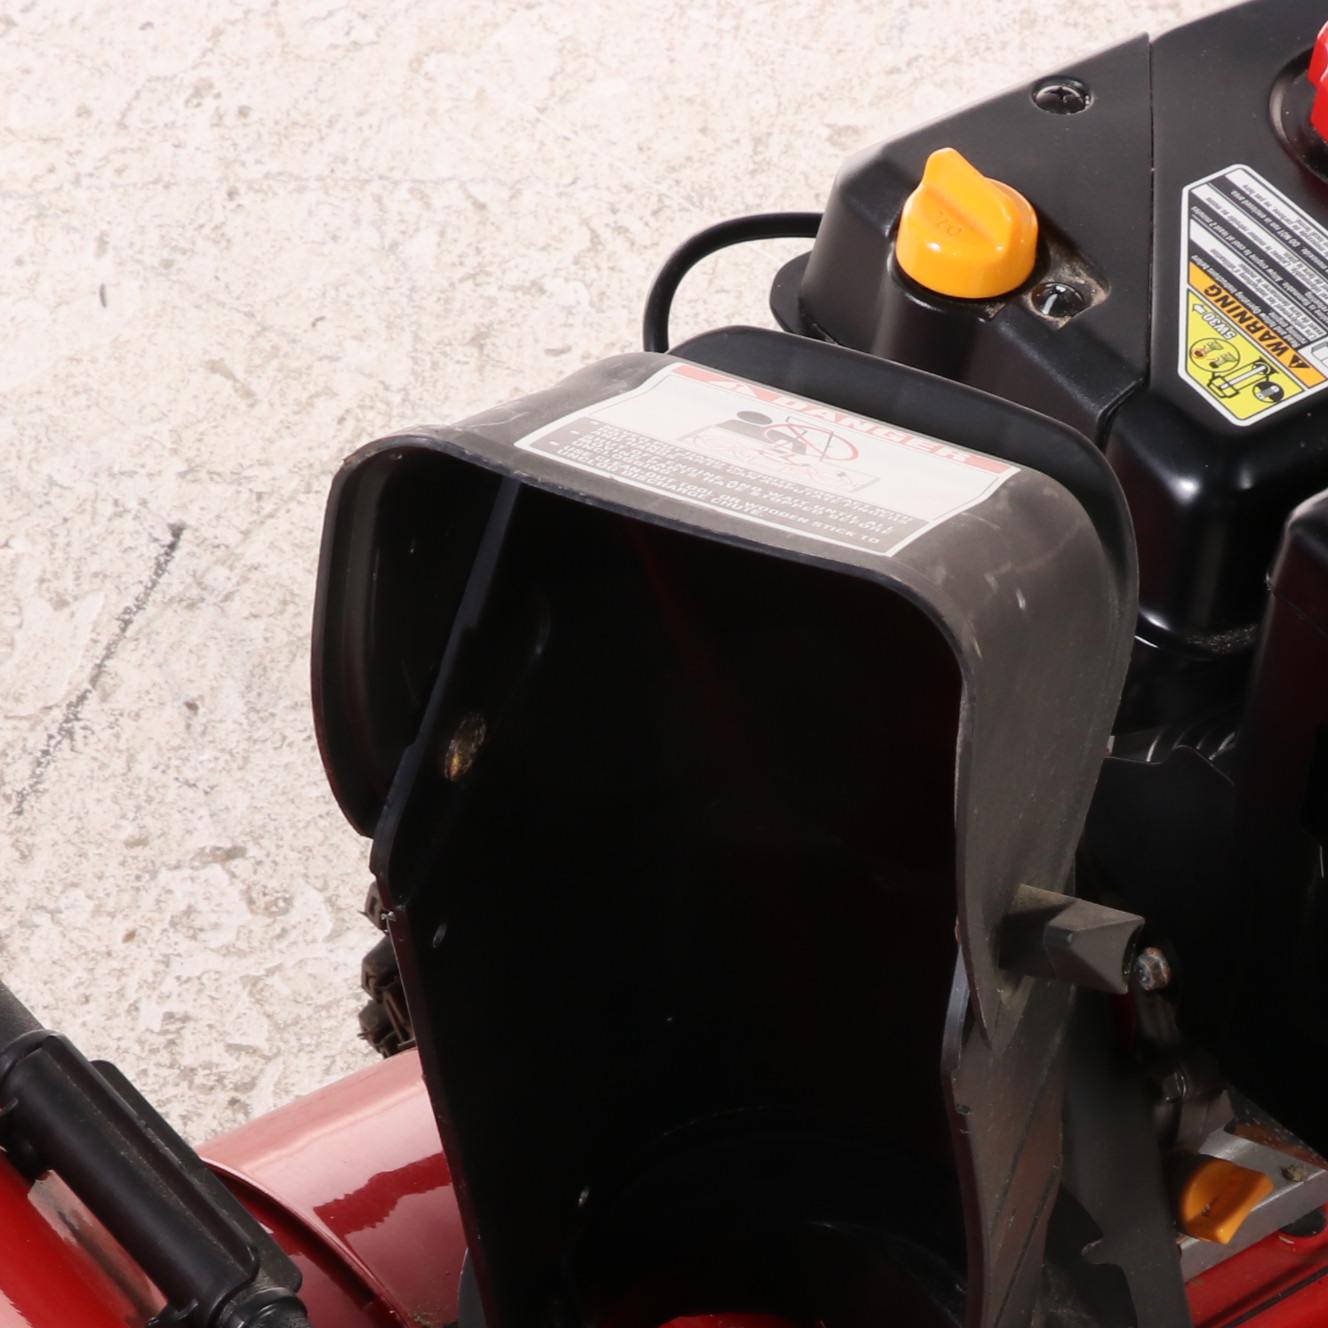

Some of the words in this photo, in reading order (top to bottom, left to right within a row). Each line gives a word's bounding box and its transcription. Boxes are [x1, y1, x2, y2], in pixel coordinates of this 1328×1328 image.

[1202, 312, 1237, 339] 5W30
[1203, 283, 1290, 354] WARNING
[768, 394, 976, 469] DANGER
